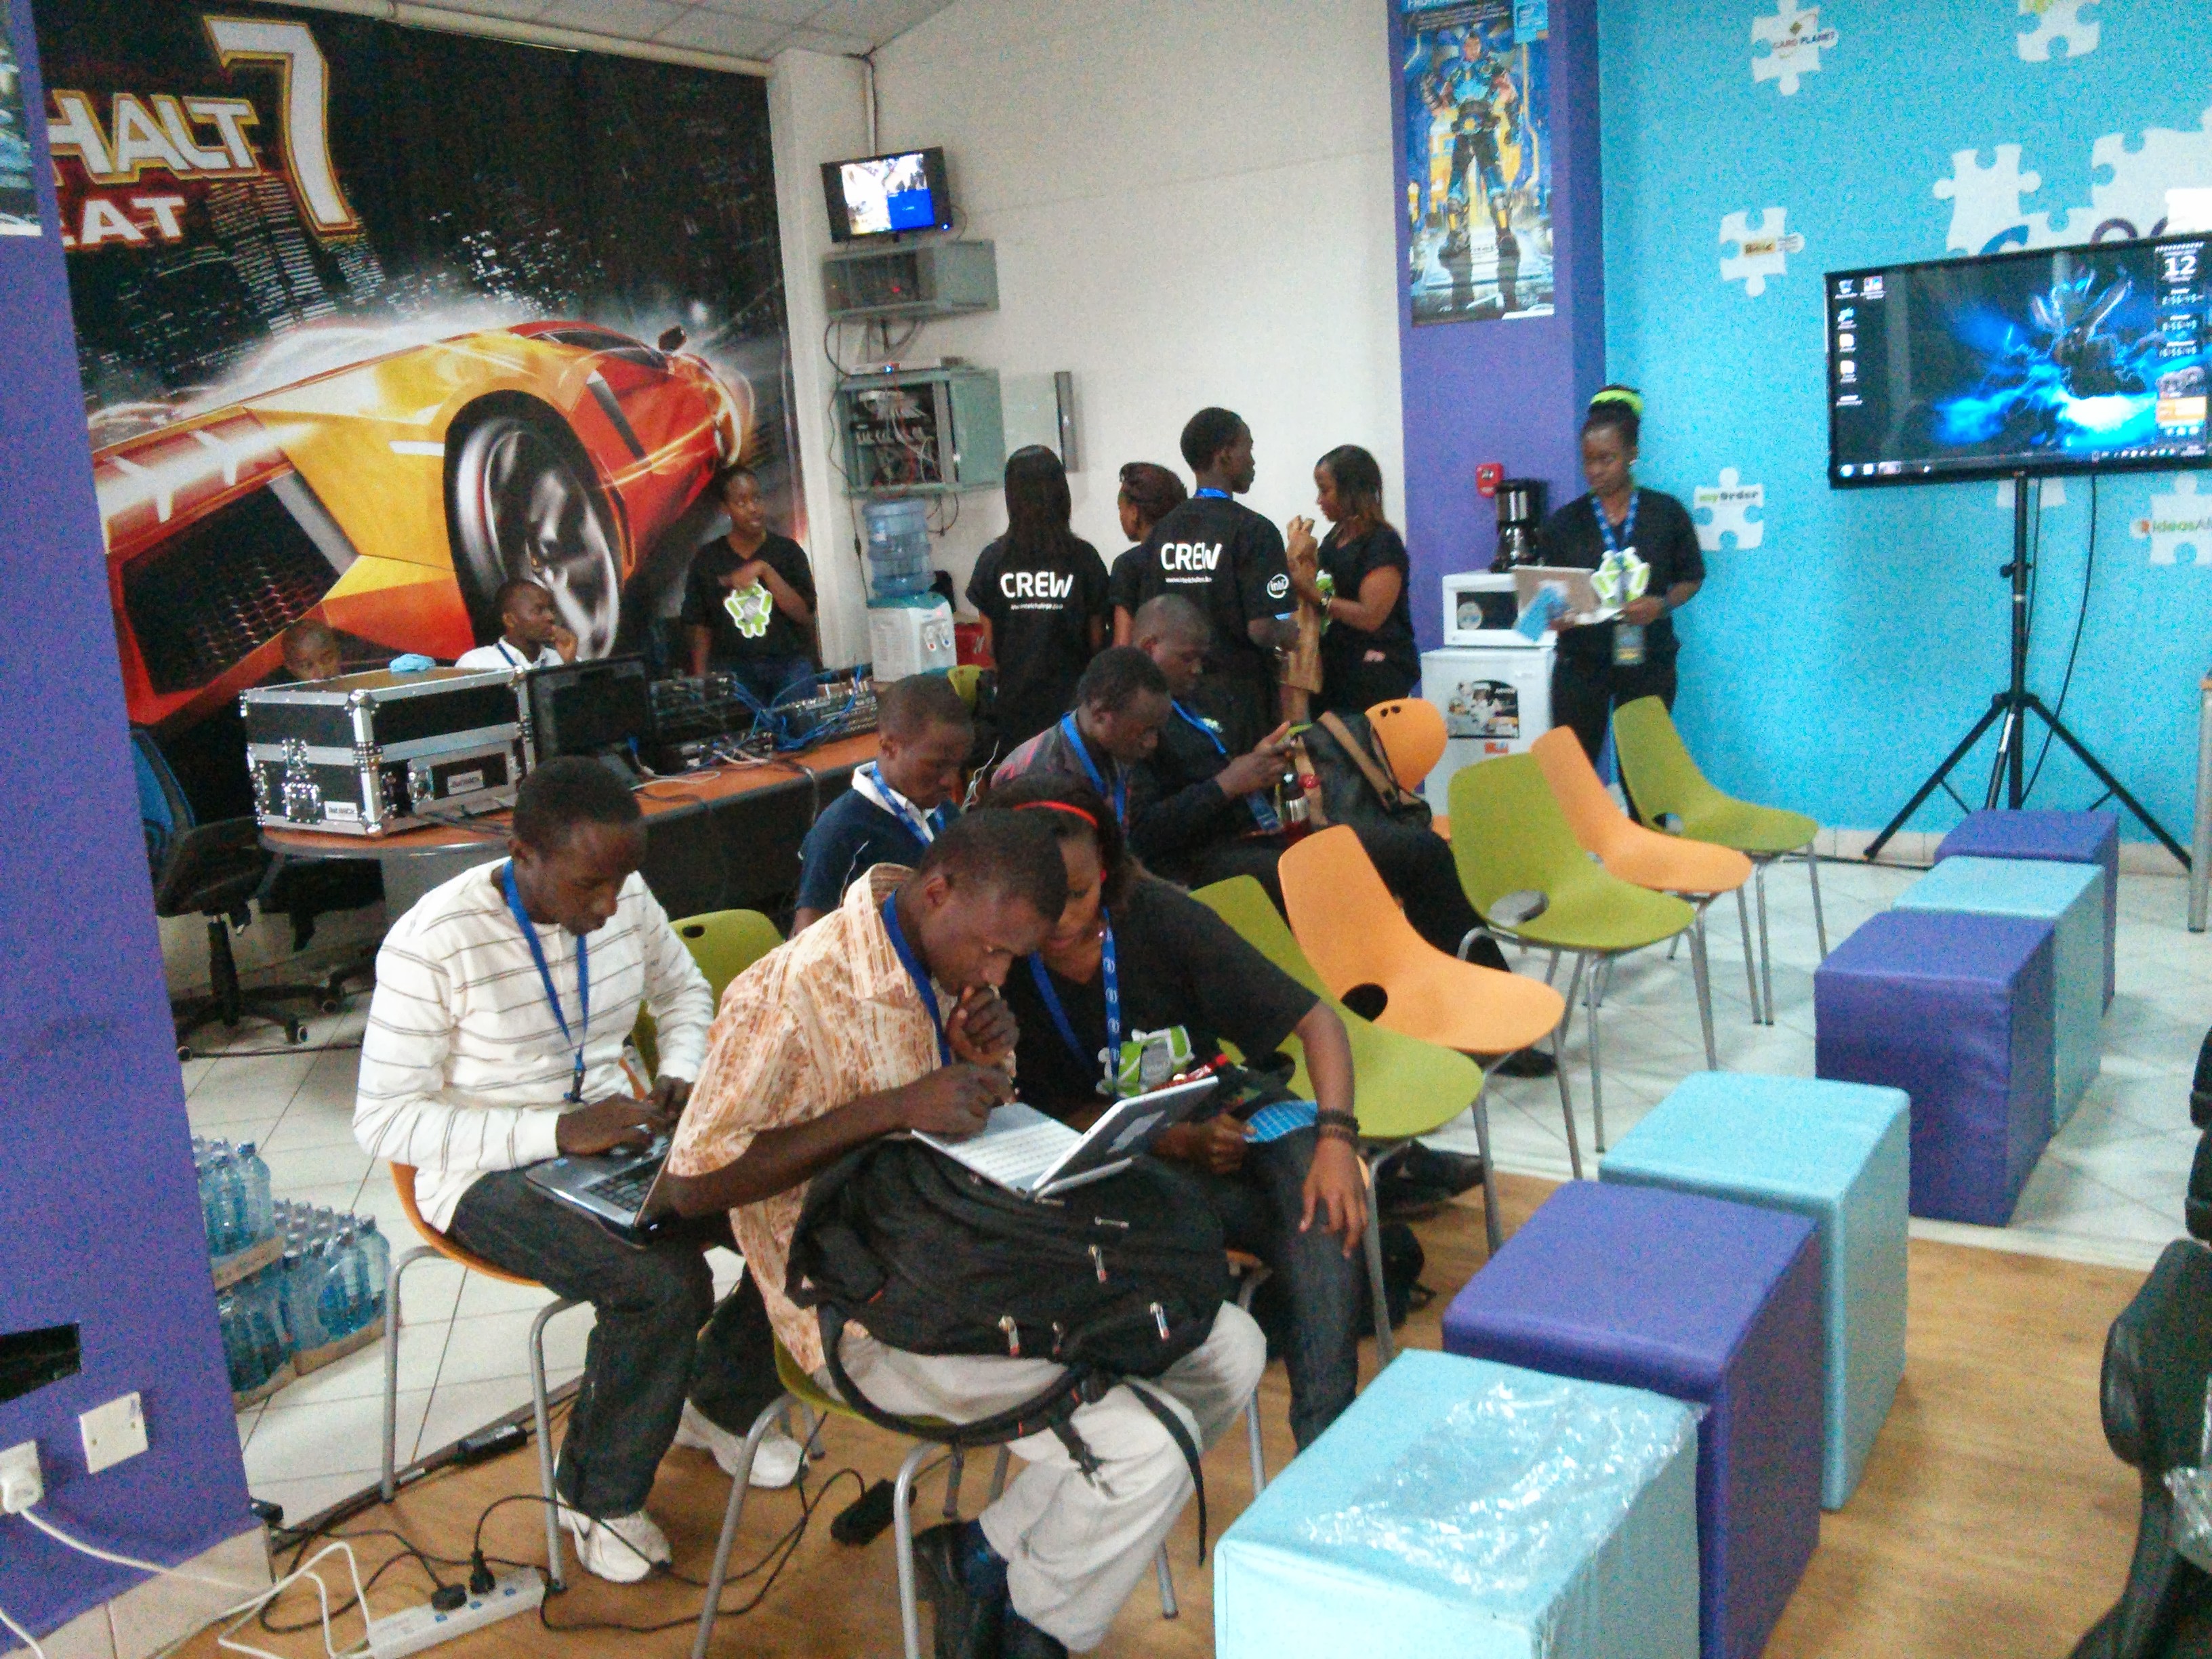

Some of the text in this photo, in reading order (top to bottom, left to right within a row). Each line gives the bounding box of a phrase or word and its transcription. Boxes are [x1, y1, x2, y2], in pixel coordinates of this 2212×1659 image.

[204, 15, 359, 237] 7
[61, 196, 186, 247] AT
[2165, 255, 2196, 277] 12
[1161, 542, 1223, 571] CREW
[1000, 571, 1073, 598] CREW
